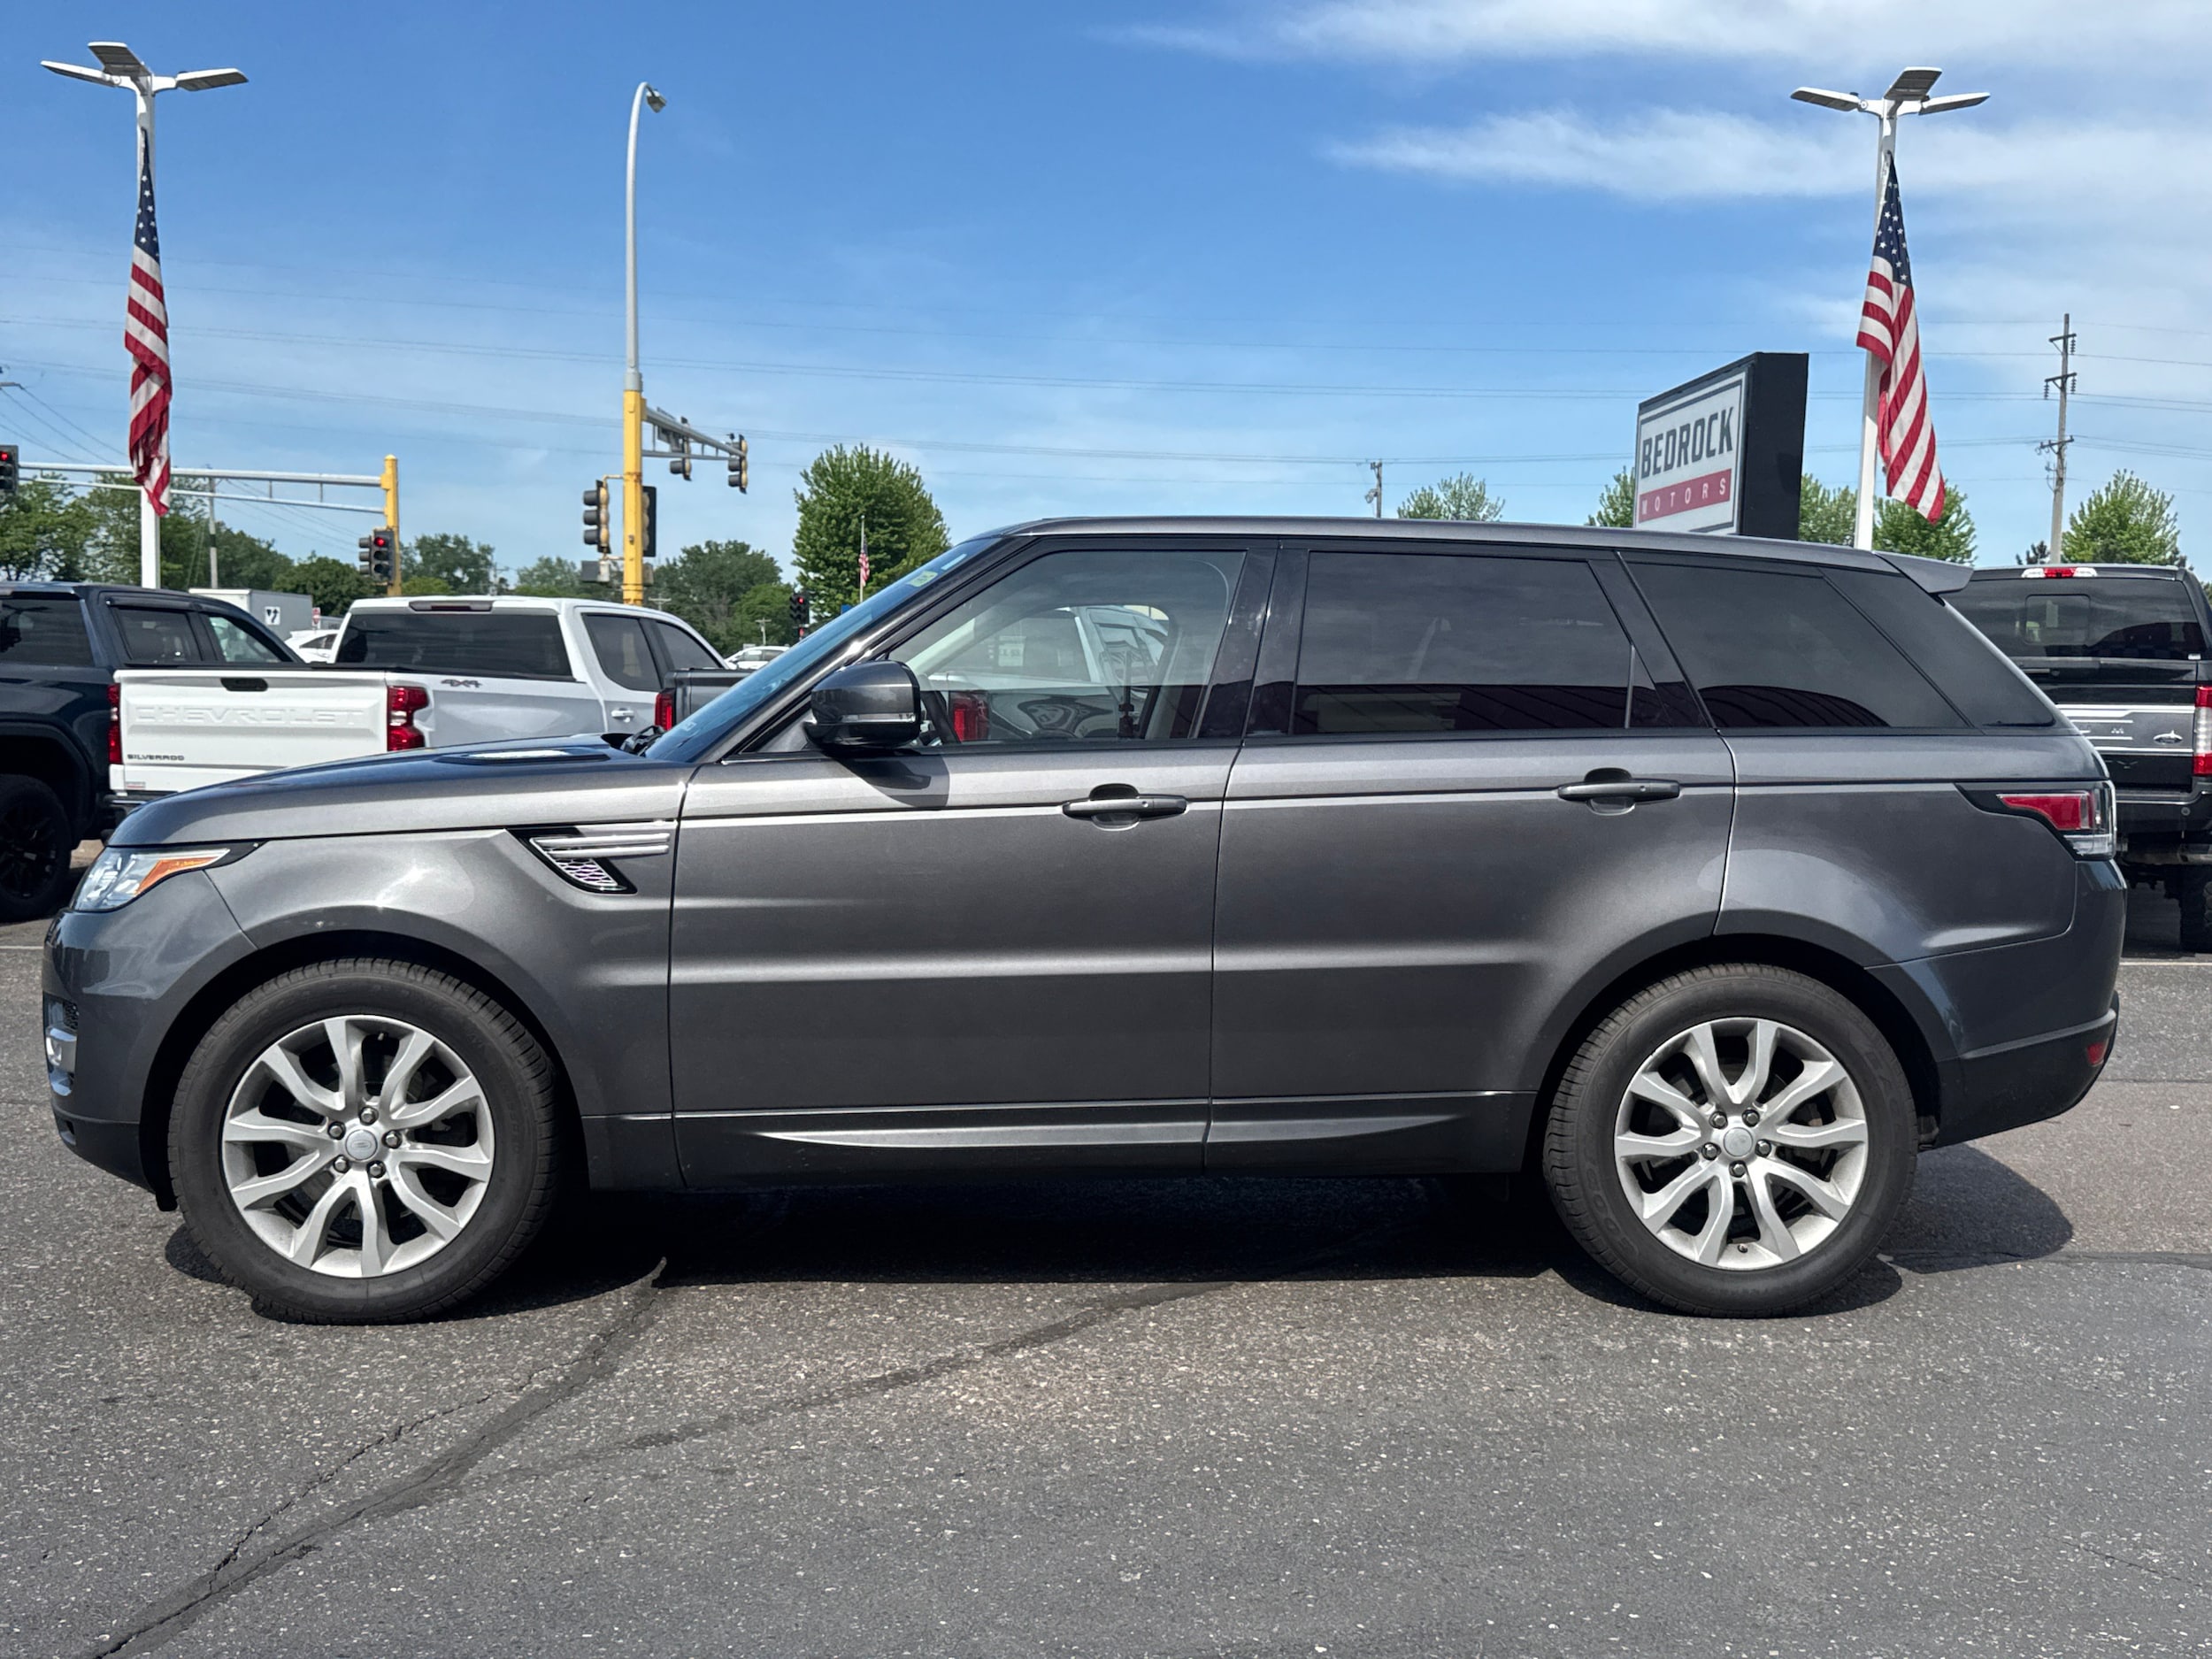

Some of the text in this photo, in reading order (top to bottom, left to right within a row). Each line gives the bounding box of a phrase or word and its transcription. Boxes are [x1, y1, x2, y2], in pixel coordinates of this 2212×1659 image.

[1641, 406, 1734, 480] BEDROCK
[1641, 477, 1726, 516] MOTORS
[134, 706, 365, 726] CHEVROLET
